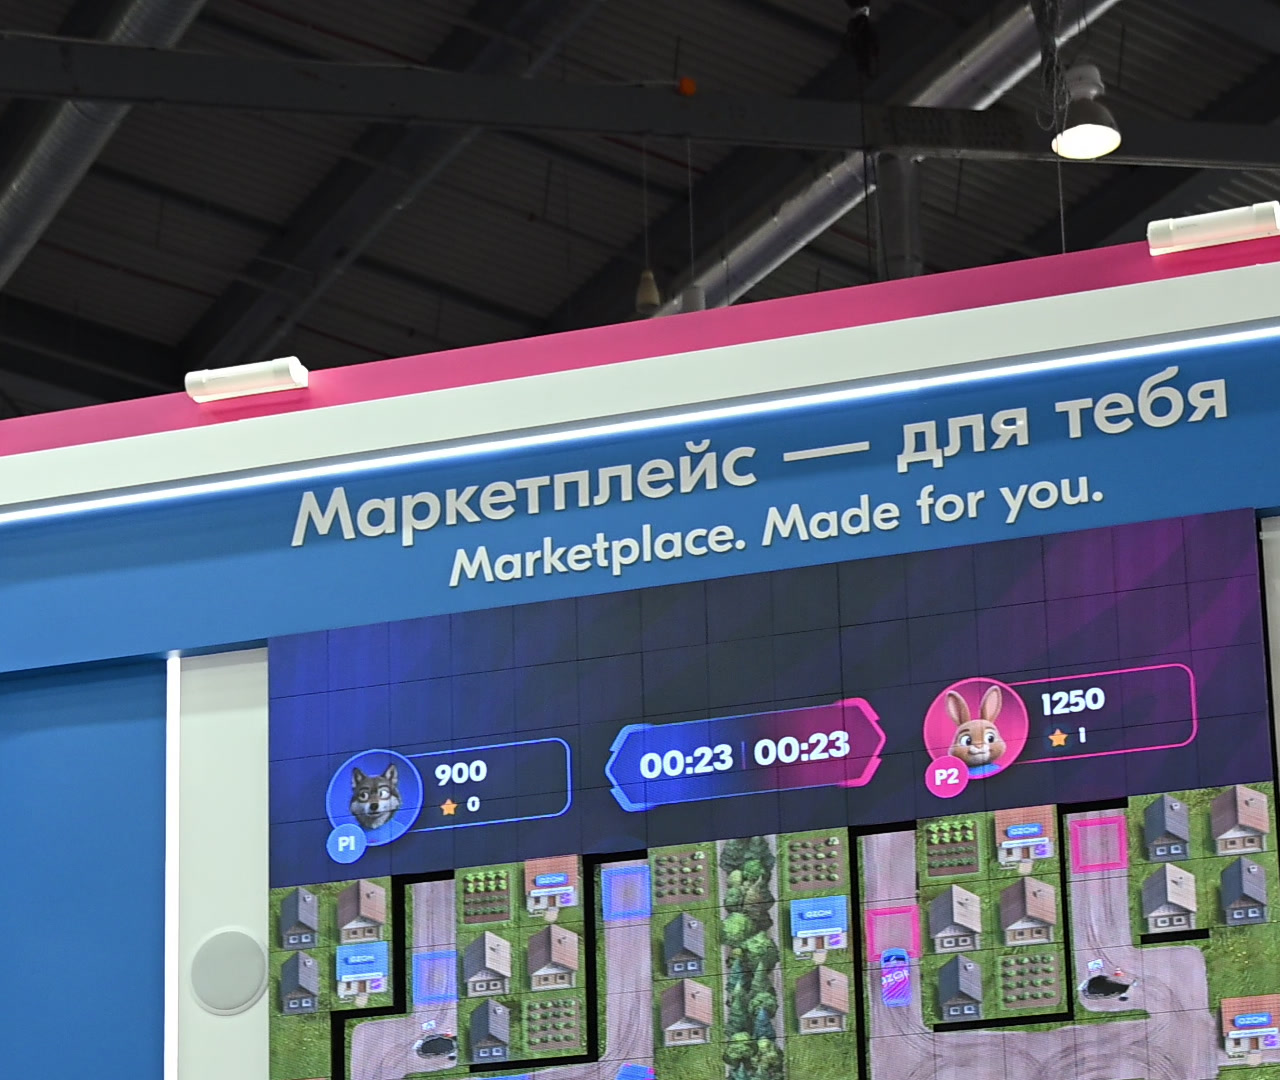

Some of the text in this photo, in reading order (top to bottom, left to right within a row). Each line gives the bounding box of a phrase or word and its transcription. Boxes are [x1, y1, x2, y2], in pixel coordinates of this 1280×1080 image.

[291, 438, 758, 547] Маркетплейс
[896, 396, 1031, 473] для
[1055, 366, 1230, 440] тебя
[450, 473, 1105, 588] Marketplace. Made for you.
[1041, 687, 1106, 717] 1250
[639, 730, 851, 780] 00:23 00:23
[434, 759, 488, 787] 900
[933, 767, 959, 786] P2
[466, 796, 480, 812] 0
